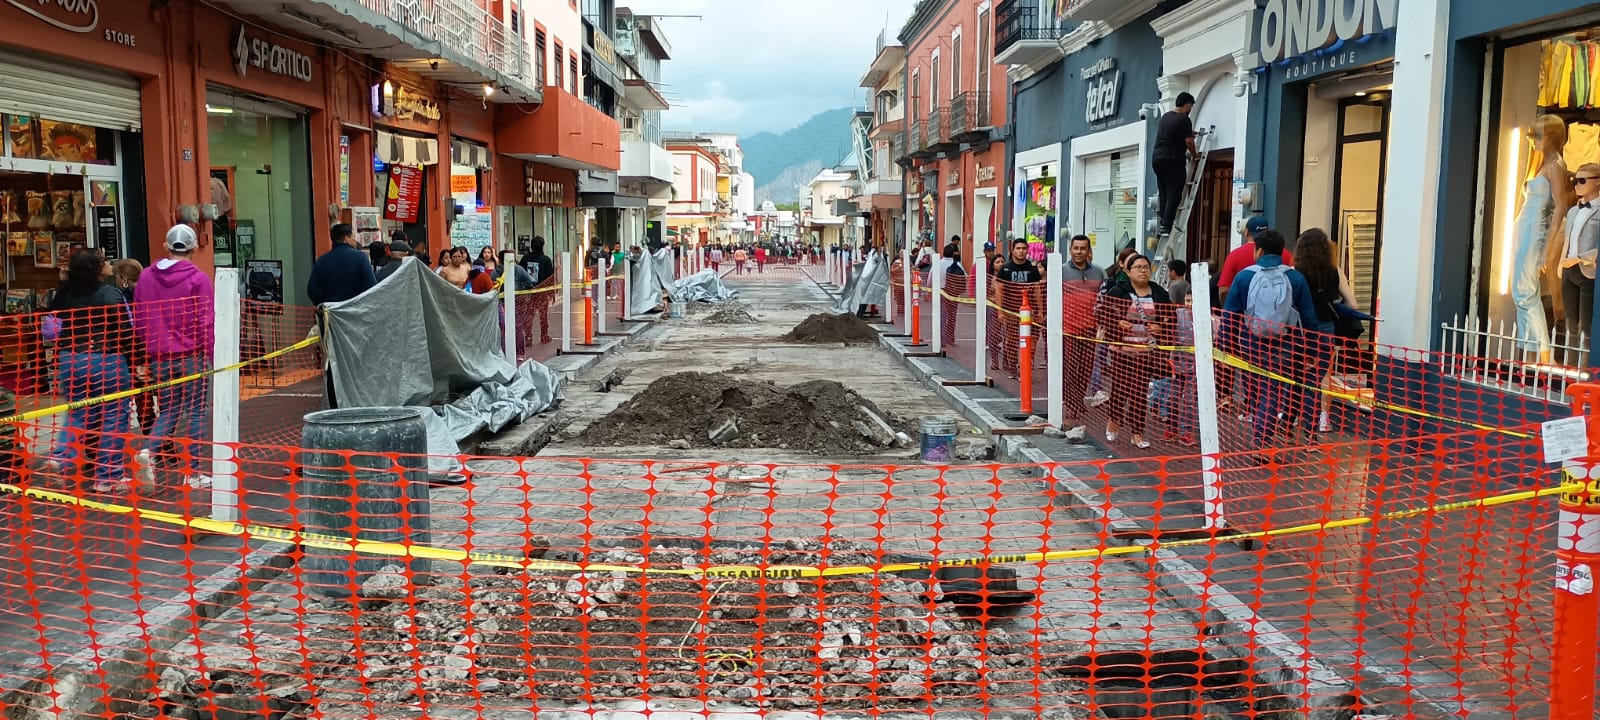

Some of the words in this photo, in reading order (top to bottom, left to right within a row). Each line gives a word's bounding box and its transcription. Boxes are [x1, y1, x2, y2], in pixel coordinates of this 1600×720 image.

[105, 28, 136, 47] STORE
[1242, 0, 1397, 71] LONDON
[1286, 51, 1356, 79] BOUTIQUE
[1086, 69, 1120, 123] telcel
[1011, 270, 1030, 282] CAT
[694, 568, 802, 579] RECAUCION
